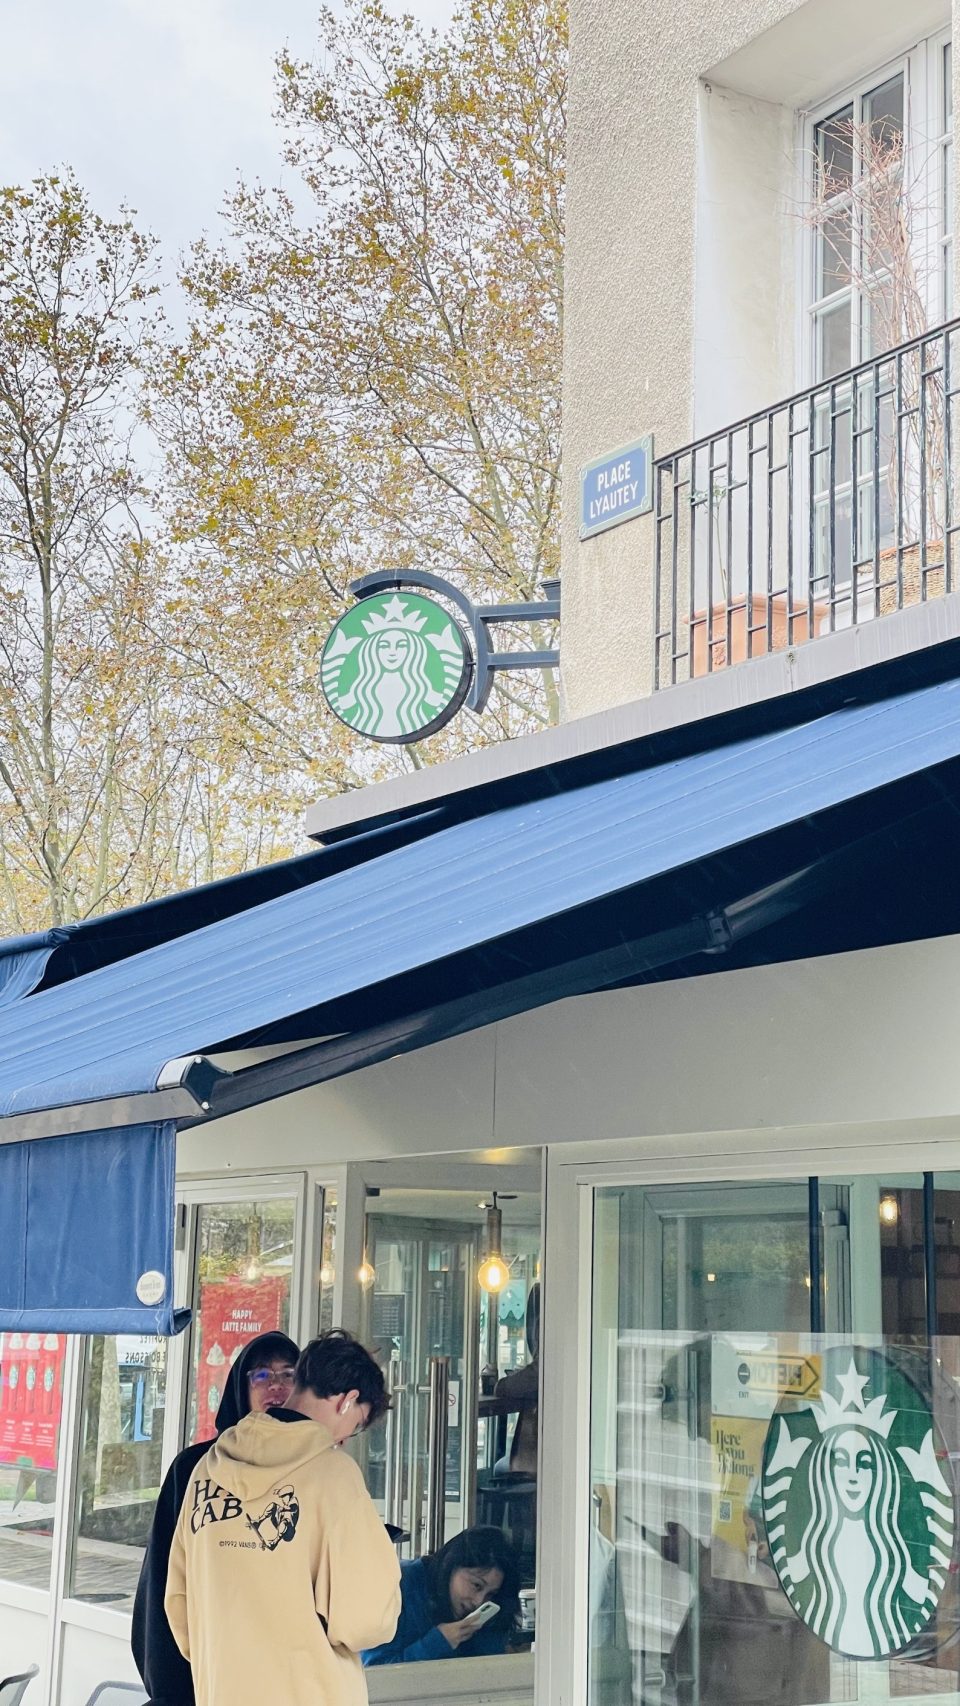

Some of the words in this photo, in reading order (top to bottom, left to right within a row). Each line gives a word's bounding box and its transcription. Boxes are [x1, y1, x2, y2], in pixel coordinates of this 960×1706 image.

[598, 460, 631, 492] PLACE
[590, 481, 638, 519] LYAUTEY
[222, 1321, 239, 1332] LATTE
[240, 1321, 262, 1332] FAMILY
[232, 1309, 253, 1319] HAPPY
[716, 1430, 741, 1450] Here
[191, 1497, 243, 1535] CAB
